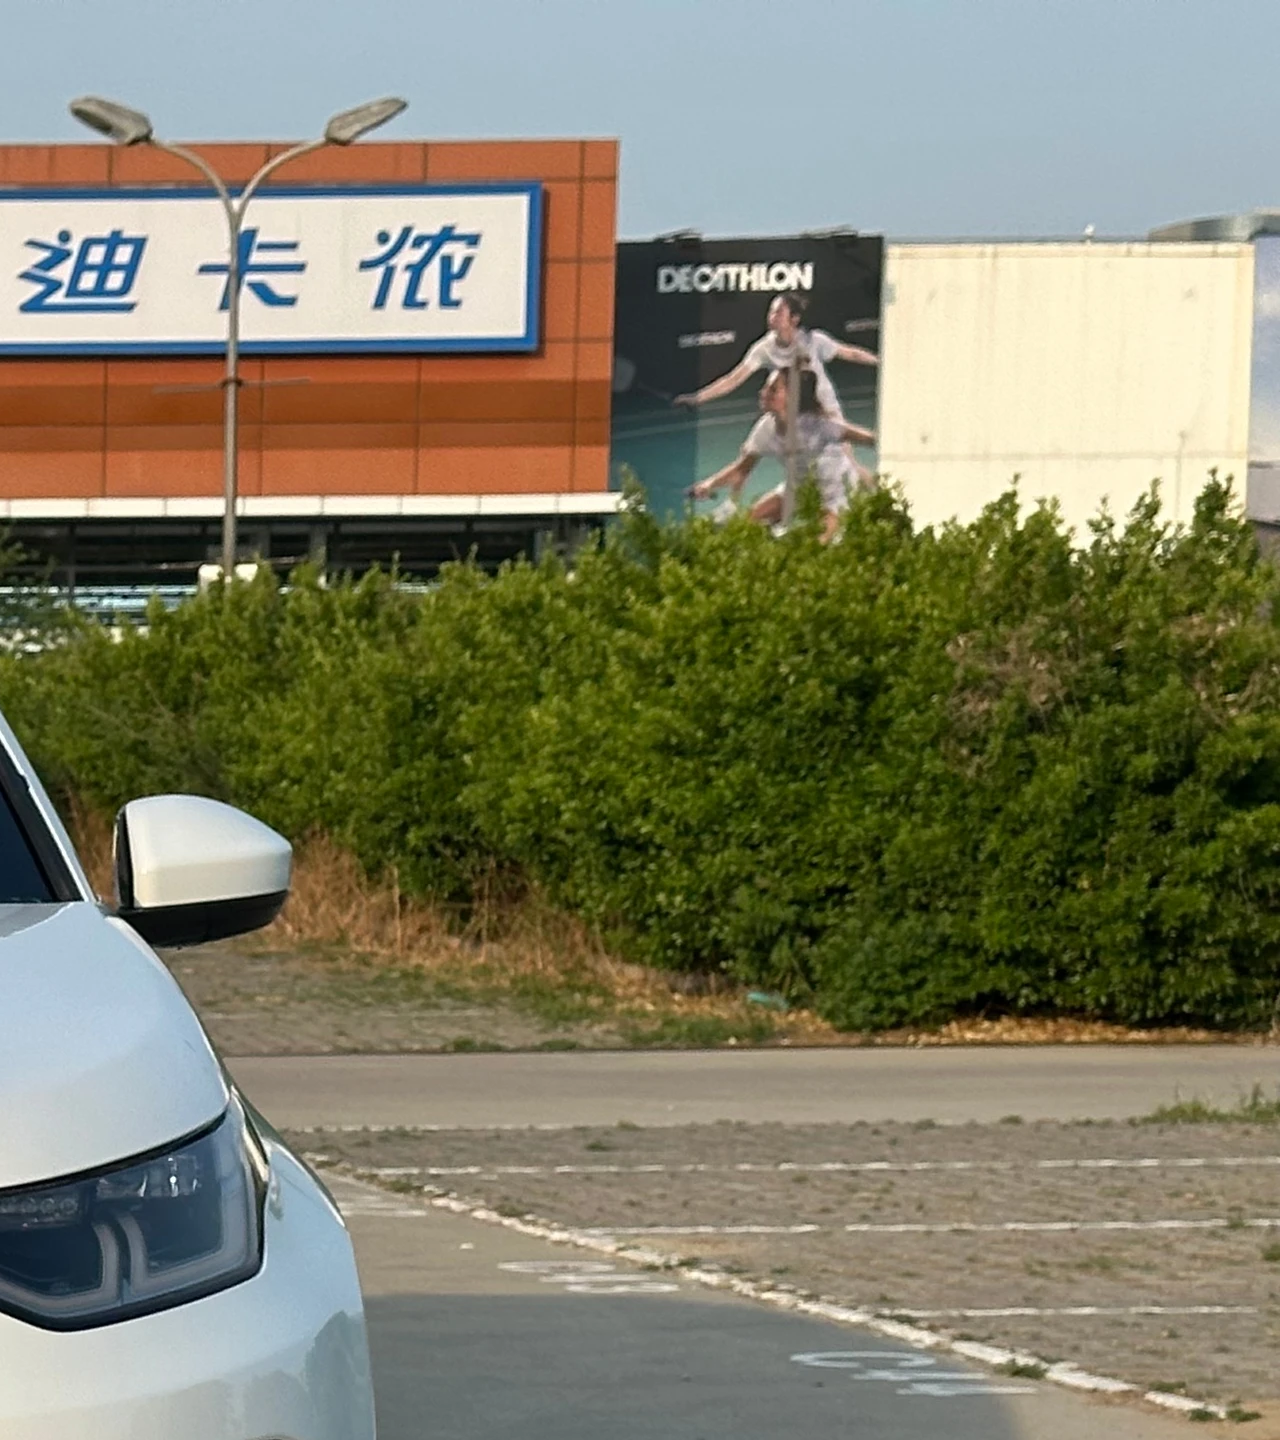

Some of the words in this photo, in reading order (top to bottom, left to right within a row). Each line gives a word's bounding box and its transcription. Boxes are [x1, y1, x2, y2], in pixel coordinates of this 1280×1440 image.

[17, 226, 482, 314] 迪卡侬
[656, 262, 814, 293] DECATHLON
